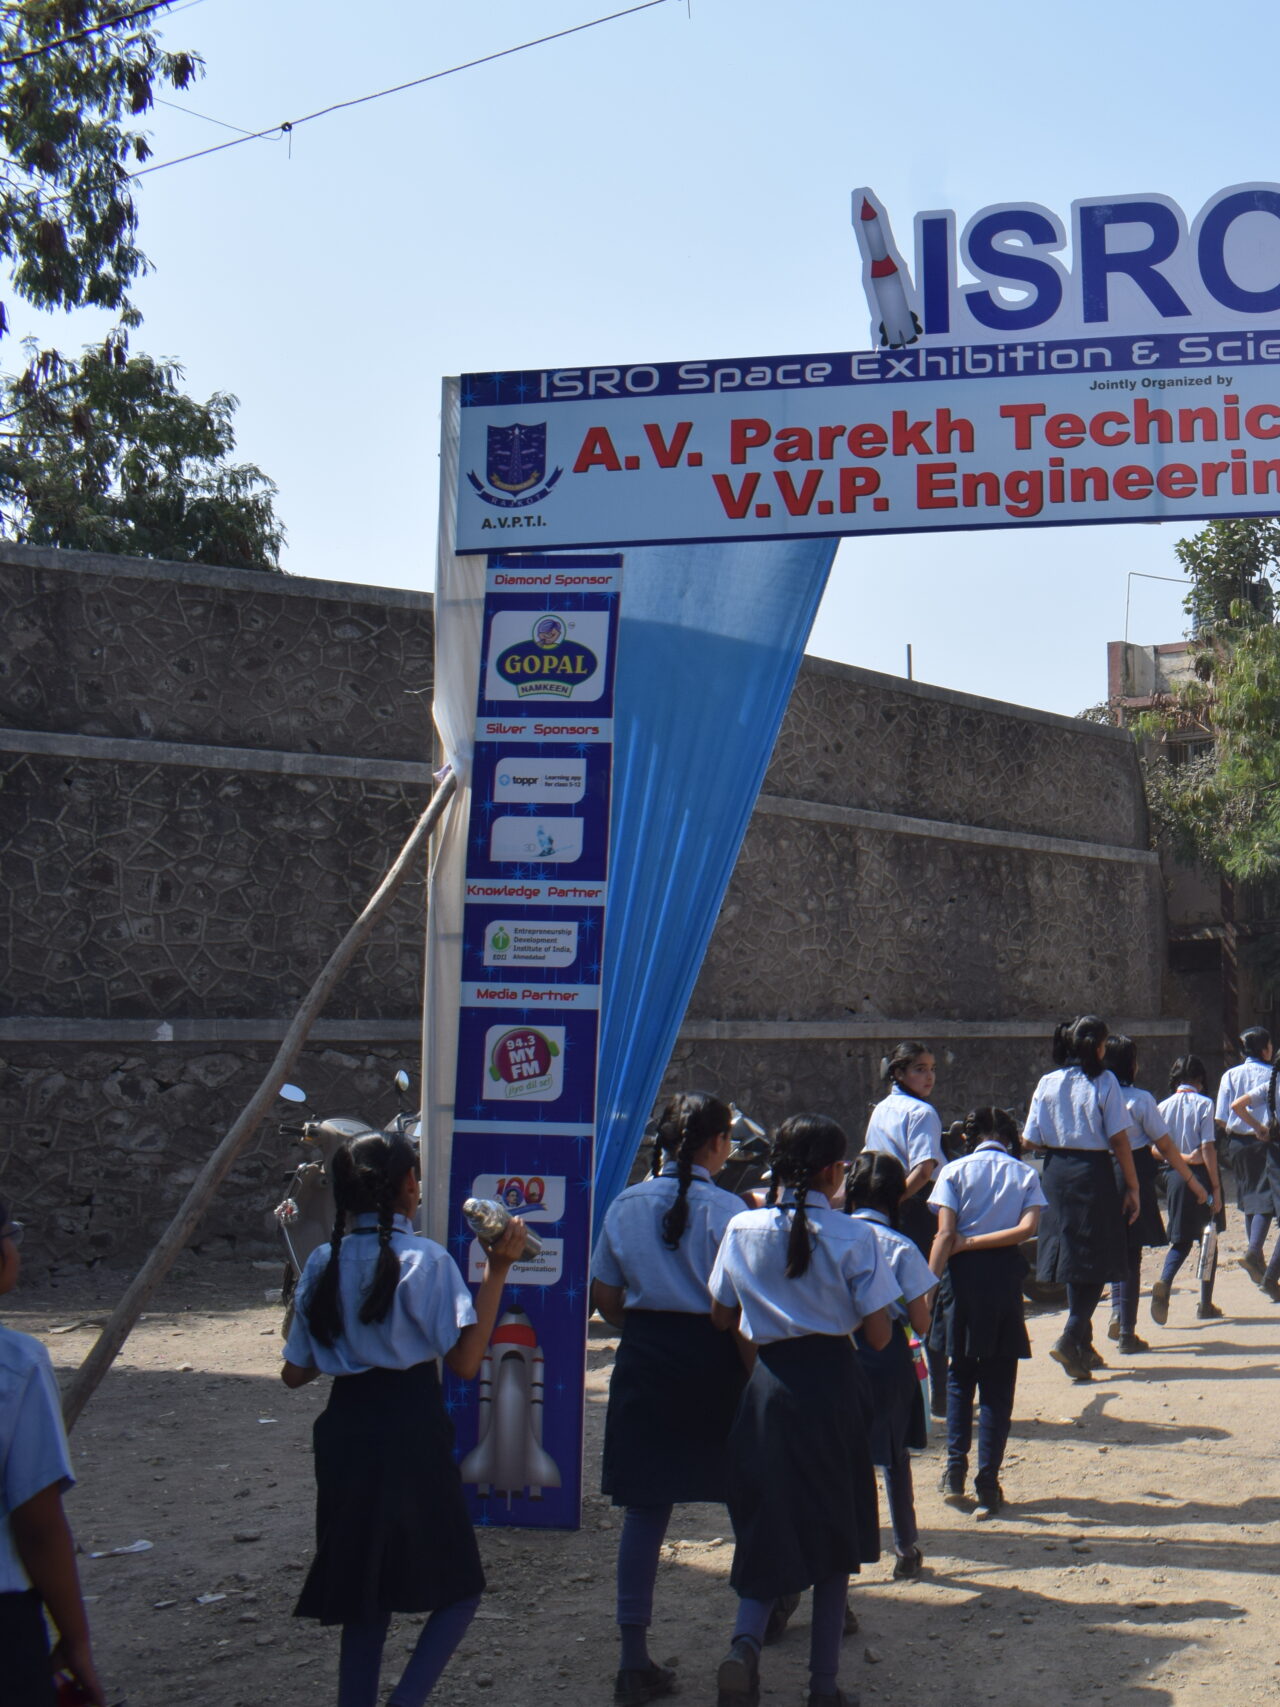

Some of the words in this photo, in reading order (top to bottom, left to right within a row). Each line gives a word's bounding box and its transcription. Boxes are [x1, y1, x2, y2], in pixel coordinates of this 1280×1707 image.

[541, 365, 661, 399] ISRO
[678, 357, 832, 393] Space
[851, 340, 1113, 381] Exhibition
[1132, 340, 1162, 366] &
[1089, 379, 1137, 391] Jointly
[1141, 375, 1212, 389] Organized
[1216, 375, 1233, 387] by
[572, 420, 703, 474] A.V.
[730, 408, 975, 466] Parekh
[712, 467, 890, 520] V.V.P.
[480, 515, 547, 530] A.V.P.T.I.
[494, 574, 551, 585] Diamond
[554, 574, 613, 587] Sponsor
[504, 655, 588, 674] GOPAL
[520, 684, 569, 694] NAMKEEN
[486, 723, 527, 734] Silver
[533, 724, 599, 736] Sponsors
[512, 776, 539, 787] toppr
[467, 885, 541, 899] Knowledge
[548, 887, 602, 898] Partner
[514, 928, 573, 936] Entrepreneurship
[476, 989, 518, 1000] Media
[521, 990, 579, 1001] Partner
[506, 1035, 536, 1050] 94.3
[509, 1046, 536, 1064] MY
[511, 1060, 540, 1080] FM
[512, 1264, 557, 1273] Organization
